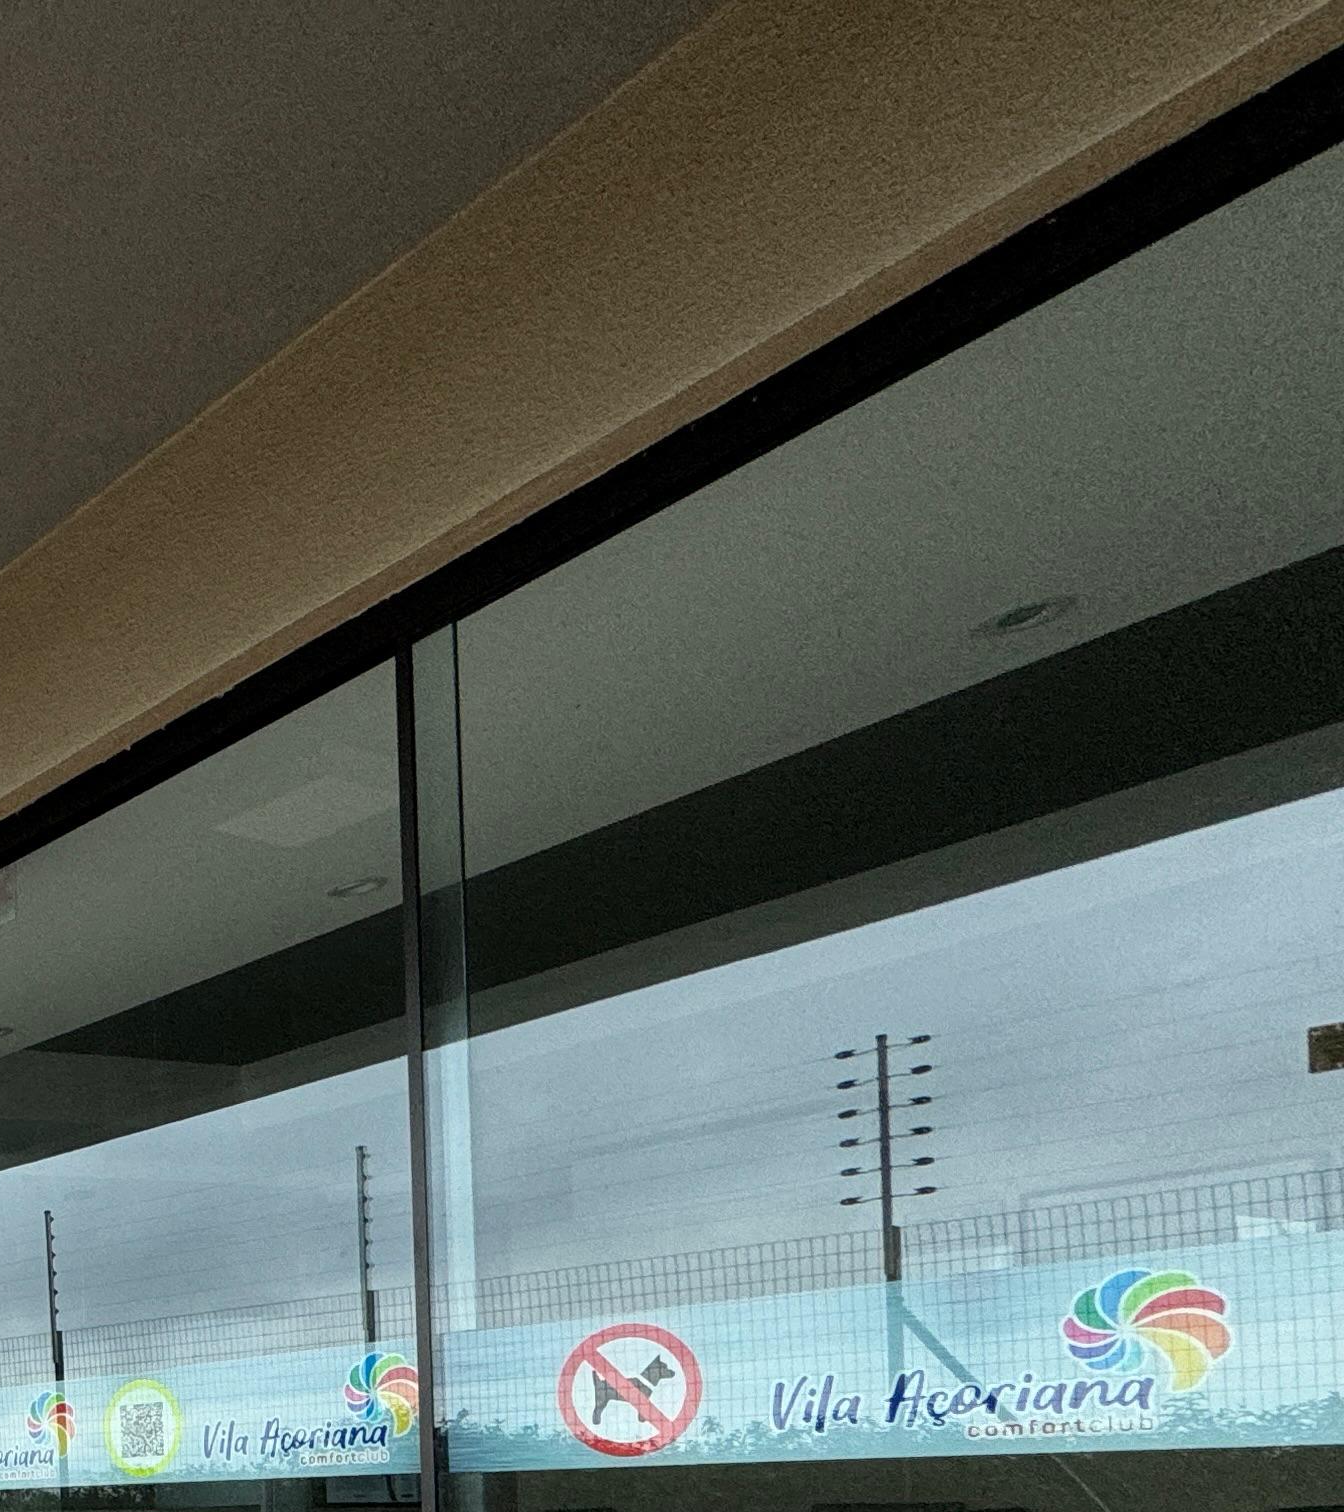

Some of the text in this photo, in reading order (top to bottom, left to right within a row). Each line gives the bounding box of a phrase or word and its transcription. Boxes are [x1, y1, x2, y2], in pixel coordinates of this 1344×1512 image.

[771, 1369, 1157, 1433] Vila Açoriana
[202, 1417, 388, 1461] Vila Açoriana
